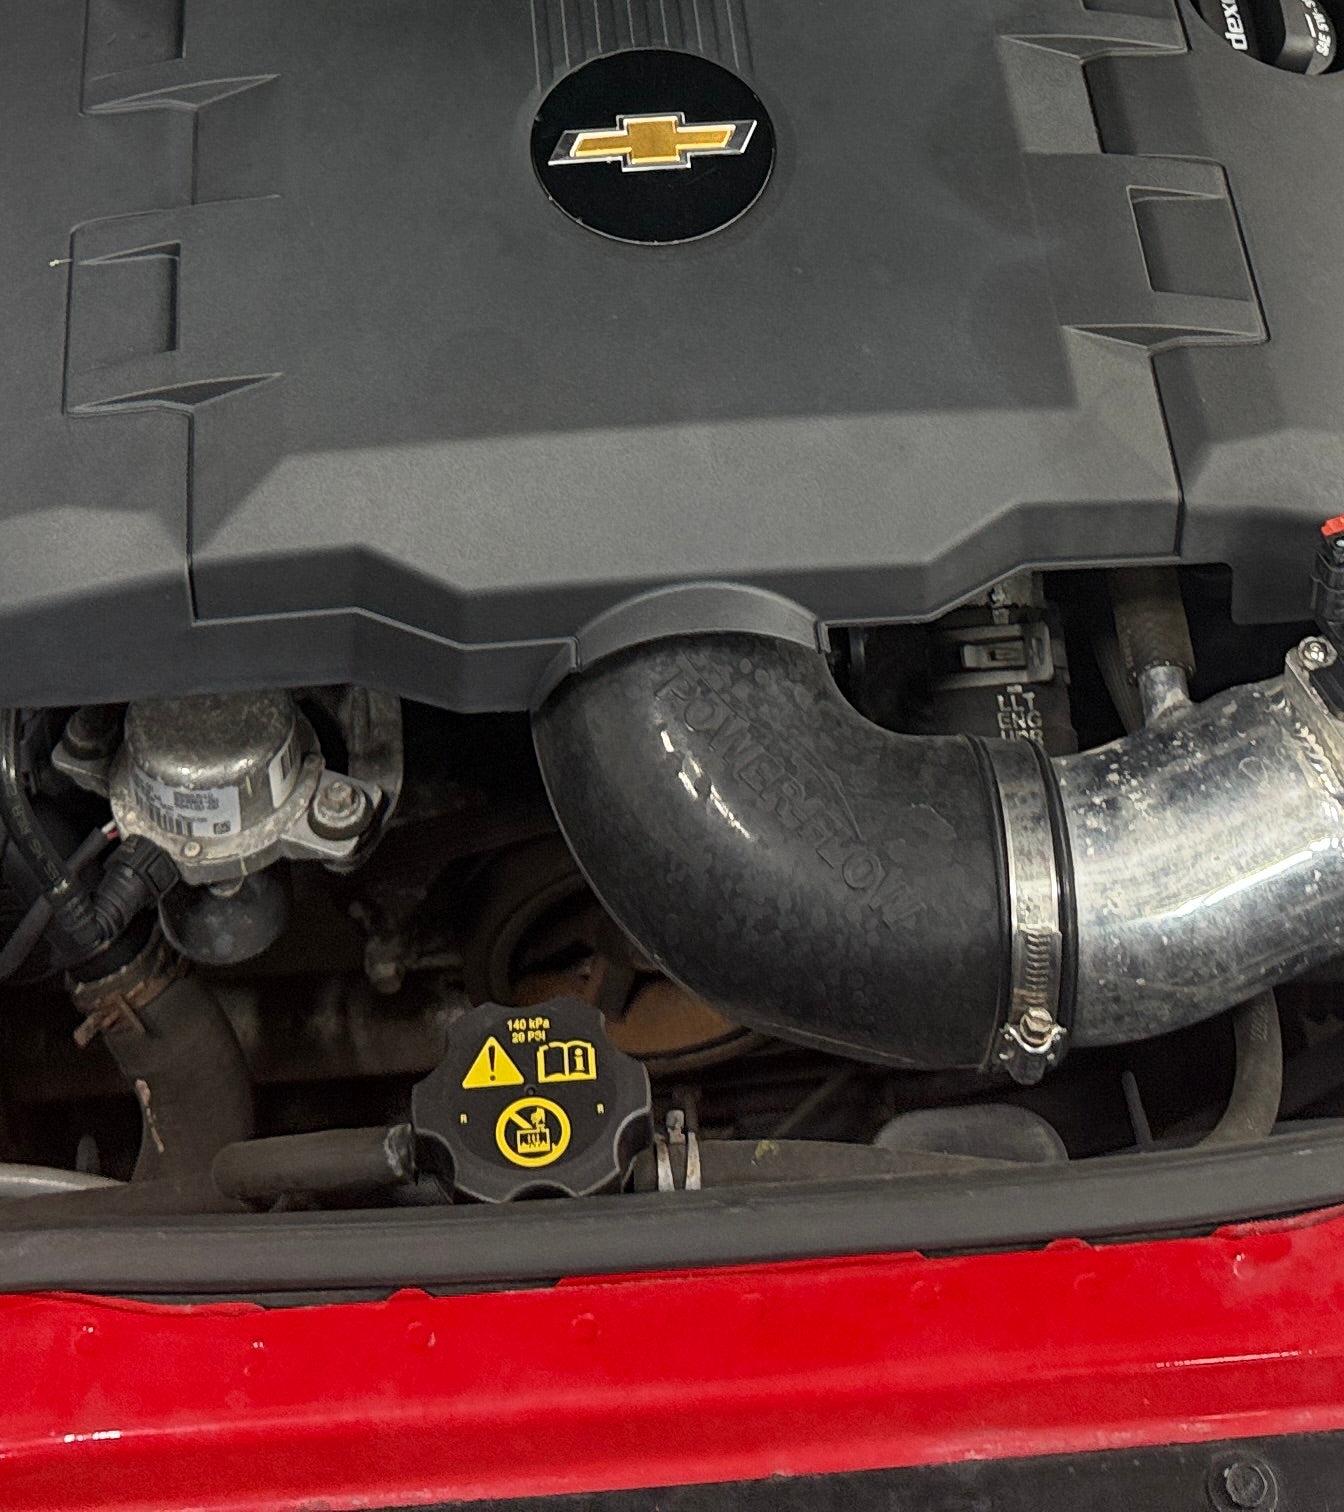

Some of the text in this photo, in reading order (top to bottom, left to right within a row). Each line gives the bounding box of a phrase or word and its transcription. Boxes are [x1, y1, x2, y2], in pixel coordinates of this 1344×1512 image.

[1315, 32, 1331, 56] SAE
[997, 691, 1035, 711] LLT
[997, 711, 1042, 729] ENG
[507, 1017, 550, 1031] 140 kPa
[512, 1030, 546, 1043] 20 PSI
